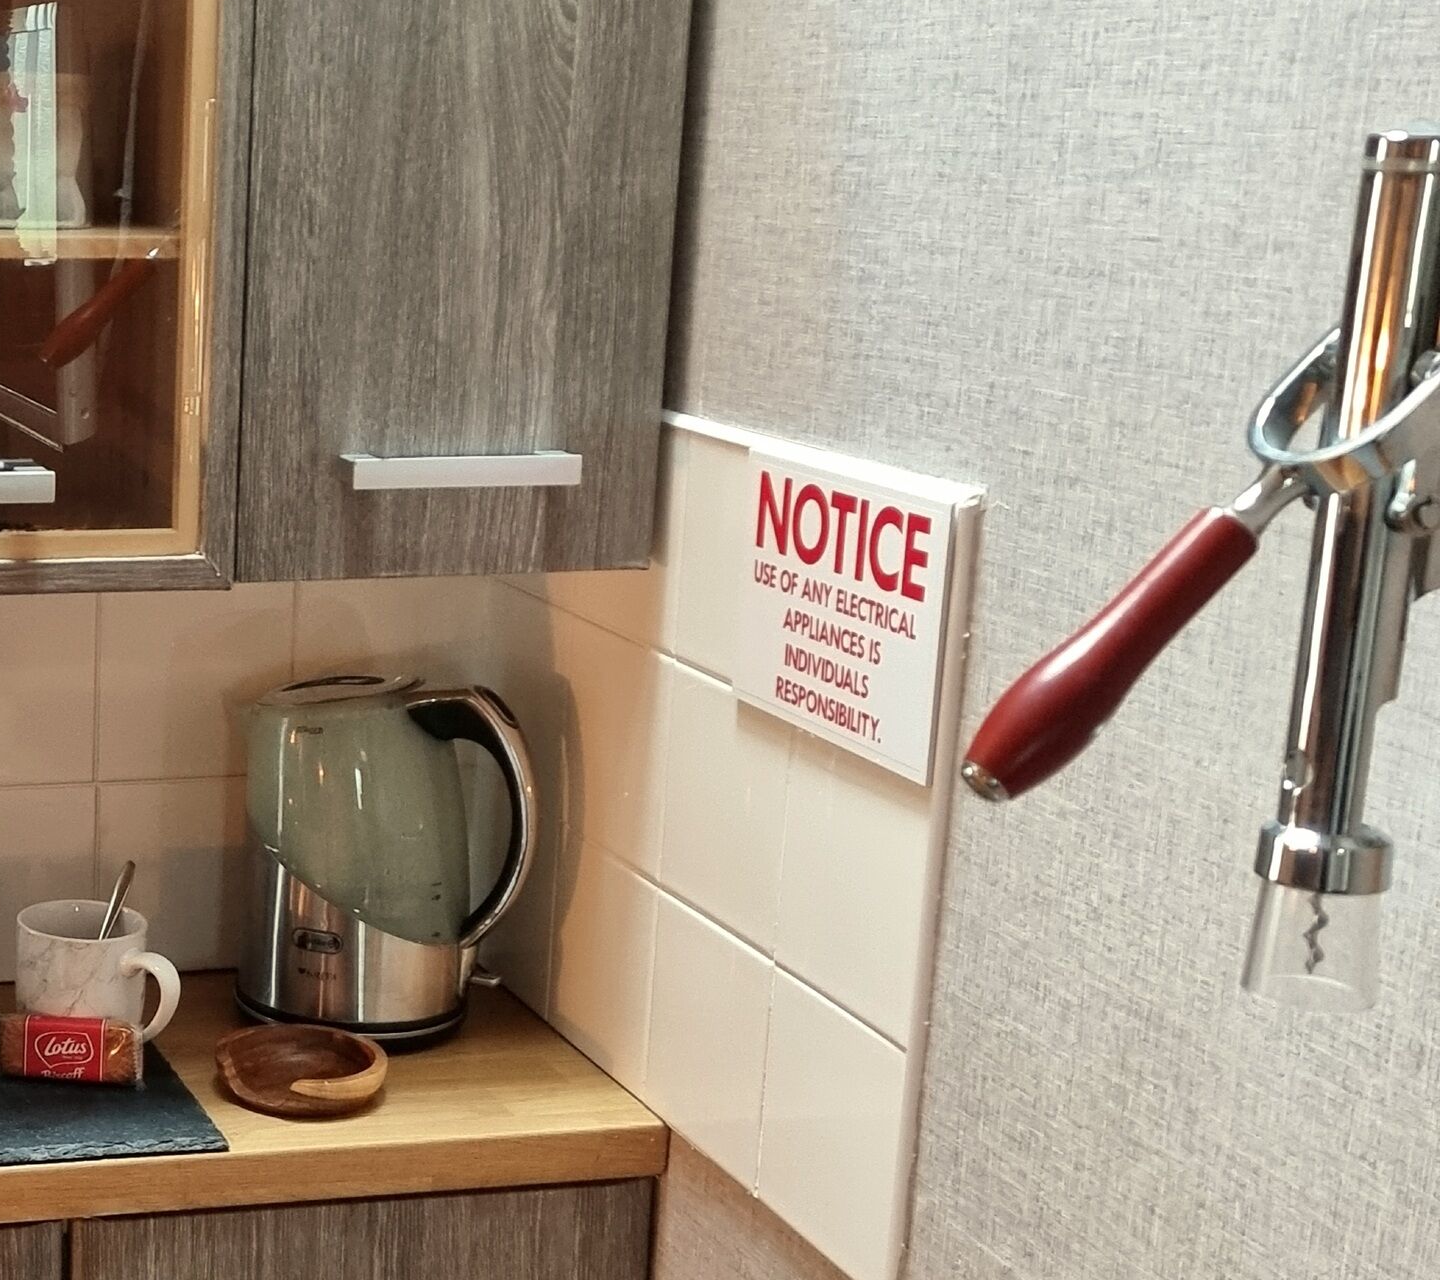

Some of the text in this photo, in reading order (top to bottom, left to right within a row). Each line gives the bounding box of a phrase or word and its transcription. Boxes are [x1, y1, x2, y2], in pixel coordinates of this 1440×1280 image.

[755, 470, 932, 602] NOTICE
[754, 559, 917, 640] USE OF ANY ELECTRICAL
[783, 608, 882, 665] APPLIANCES IS
[784, 643, 869, 699] INDIVIDUALS
[775, 675, 881, 744] RESPONSIBILITY.
[44, 1036, 88, 1056] Lotus
